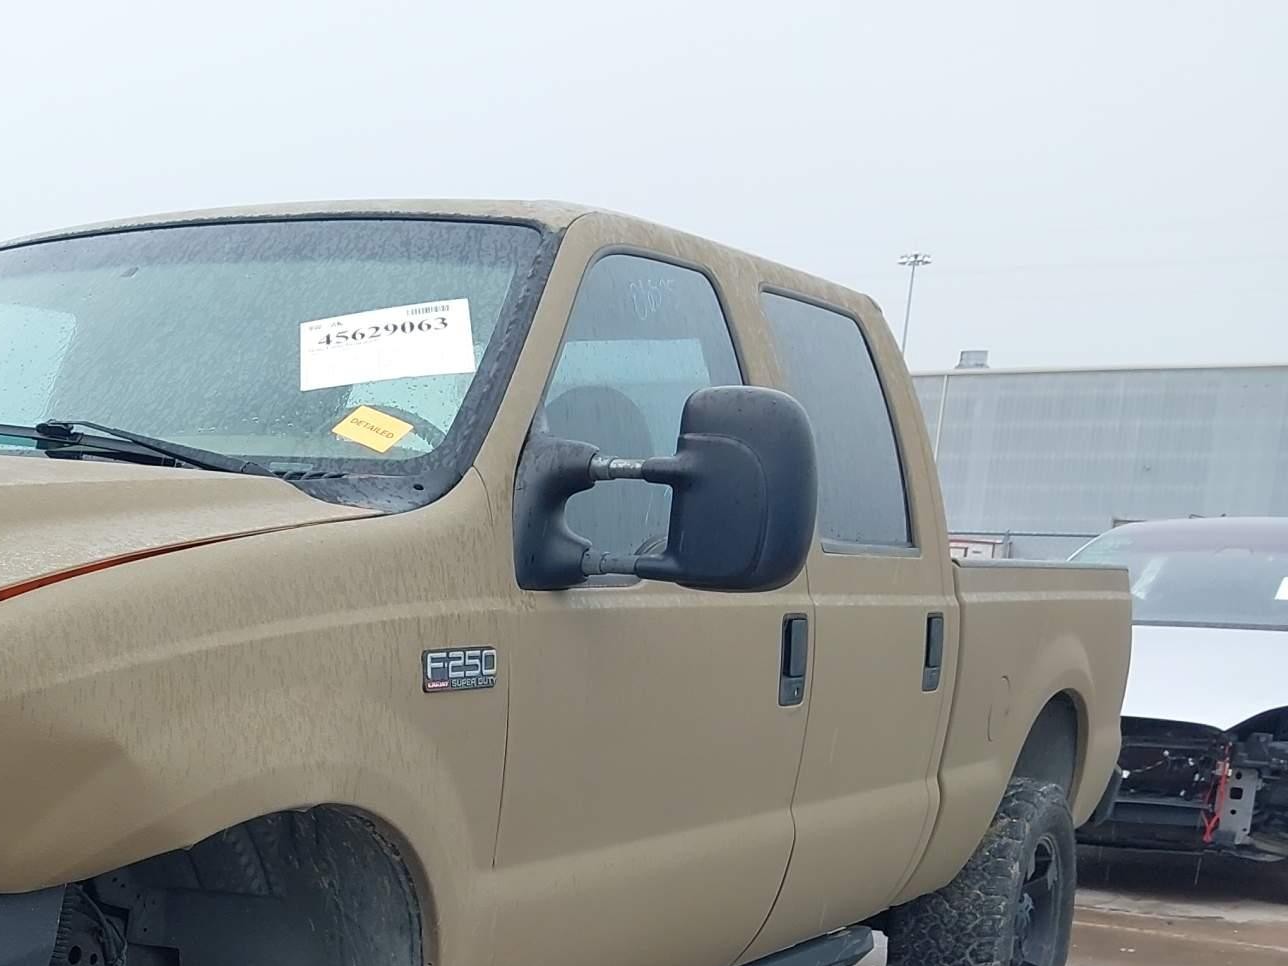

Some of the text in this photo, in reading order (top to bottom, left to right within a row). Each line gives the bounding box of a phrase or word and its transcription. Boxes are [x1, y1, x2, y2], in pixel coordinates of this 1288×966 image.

[317, 317, 449, 346] 45629063
[349, 417, 395, 440] DETAILED
[427, 649, 497, 680] F250
[451, 678, 477, 688] SUPER
[478, 676, 497, 686] DUTY
